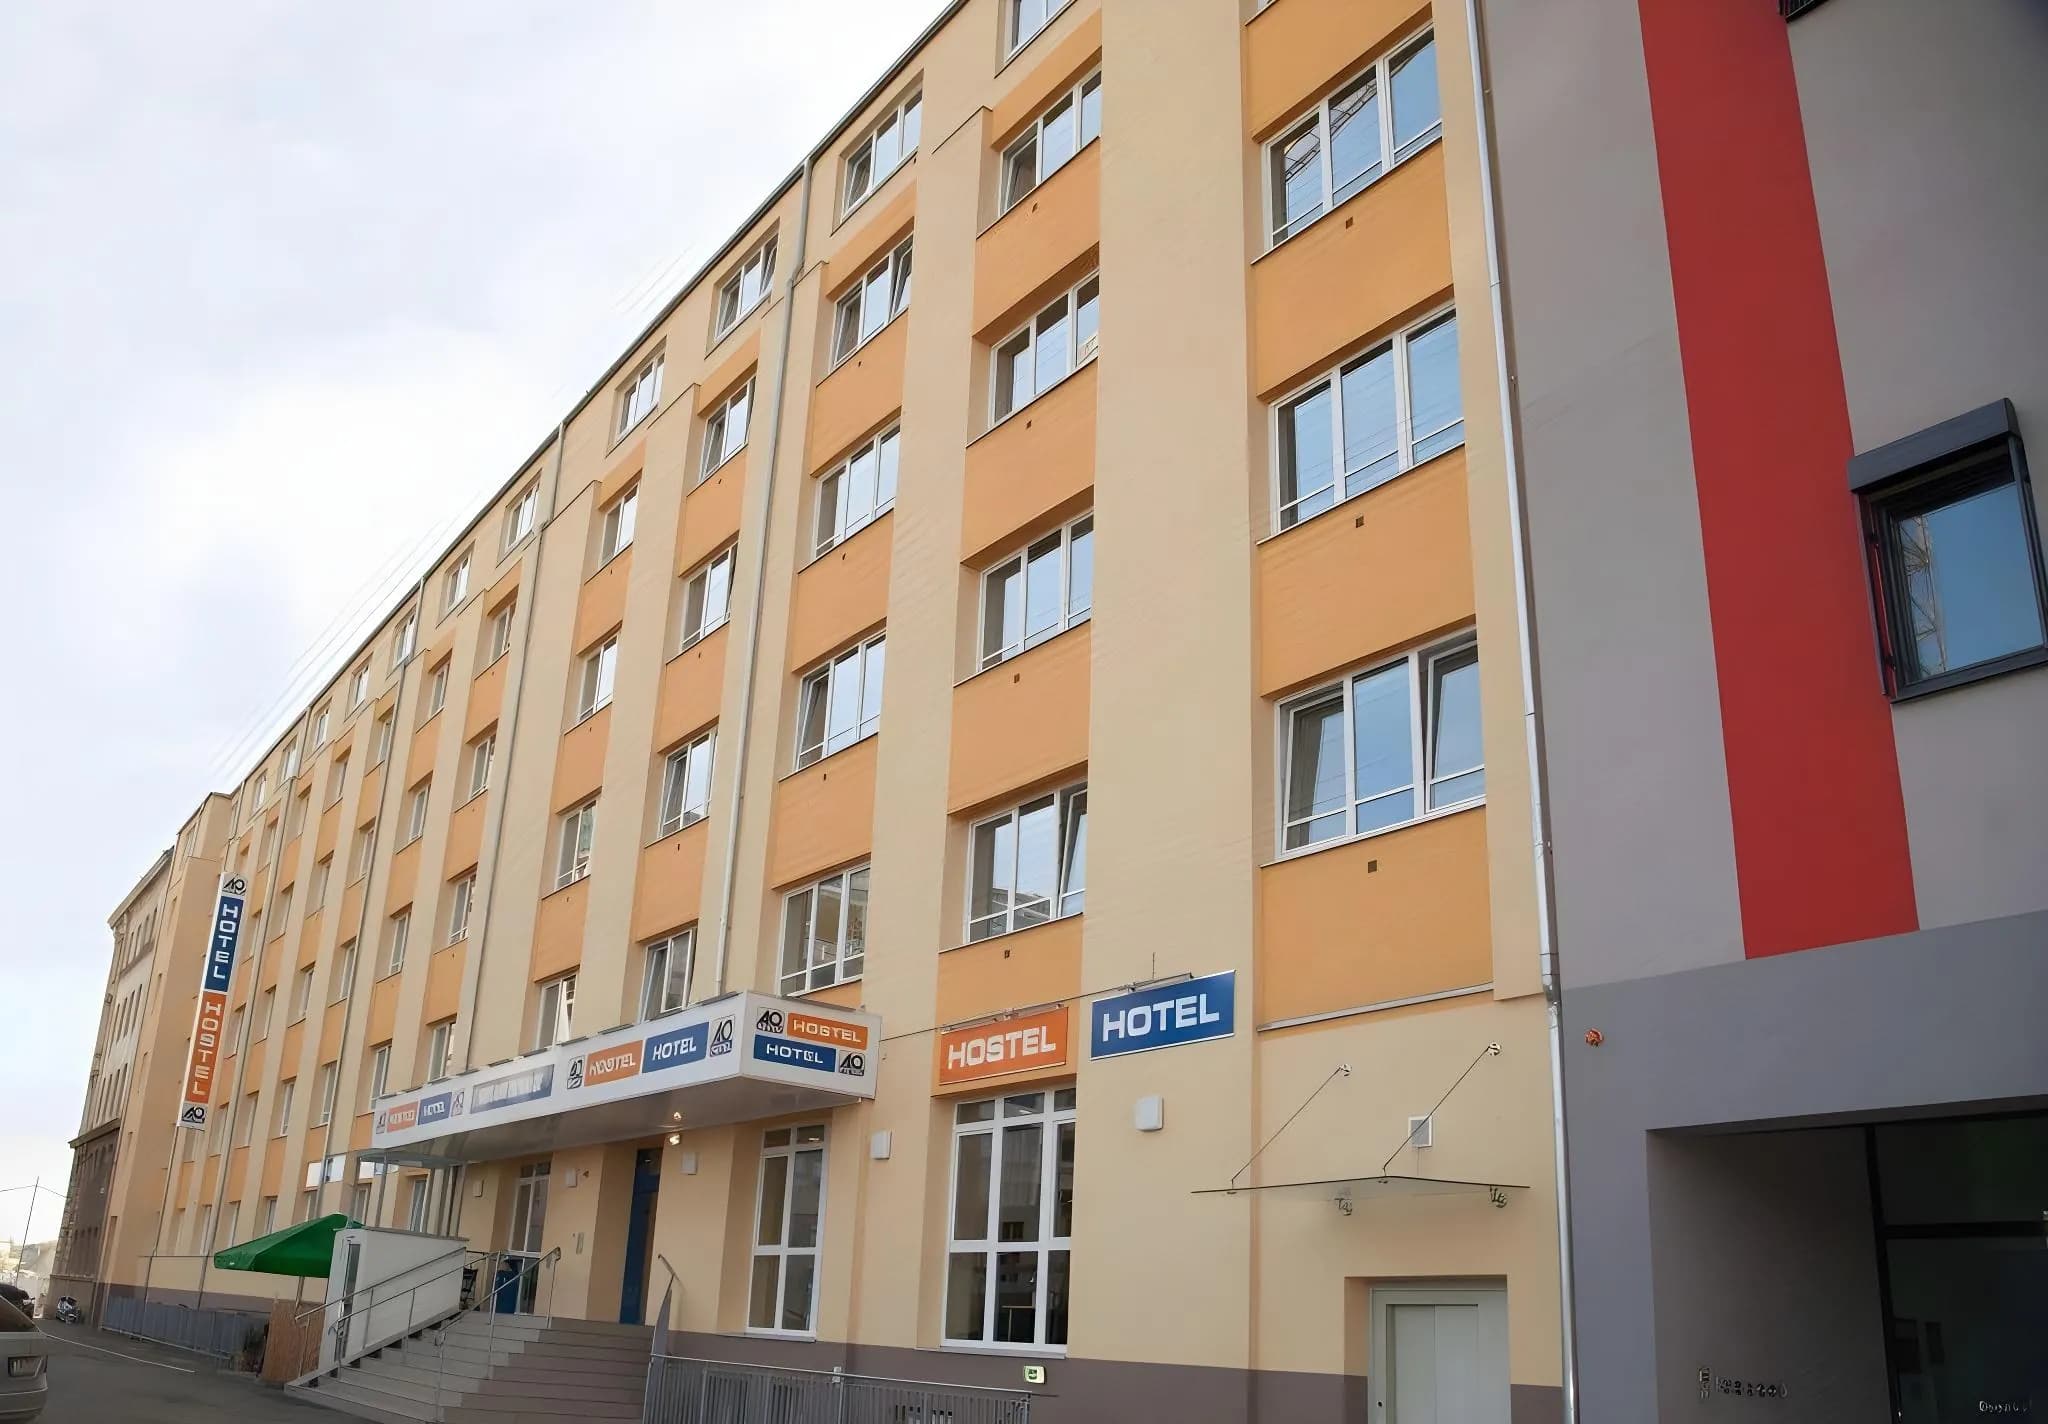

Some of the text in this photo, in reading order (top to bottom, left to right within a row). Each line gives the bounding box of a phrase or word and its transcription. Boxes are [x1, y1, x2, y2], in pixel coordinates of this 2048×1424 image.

[213, 903, 239, 979] HOTEL
[1102, 993, 1220, 1042] HOTEL
[192, 1001, 222, 1096] HOSTEL
[652, 1036, 697, 1061] HOTEL
[766, 1043, 823, 1064] HOTEL
[947, 1025, 1056, 1070] HOSTEL
